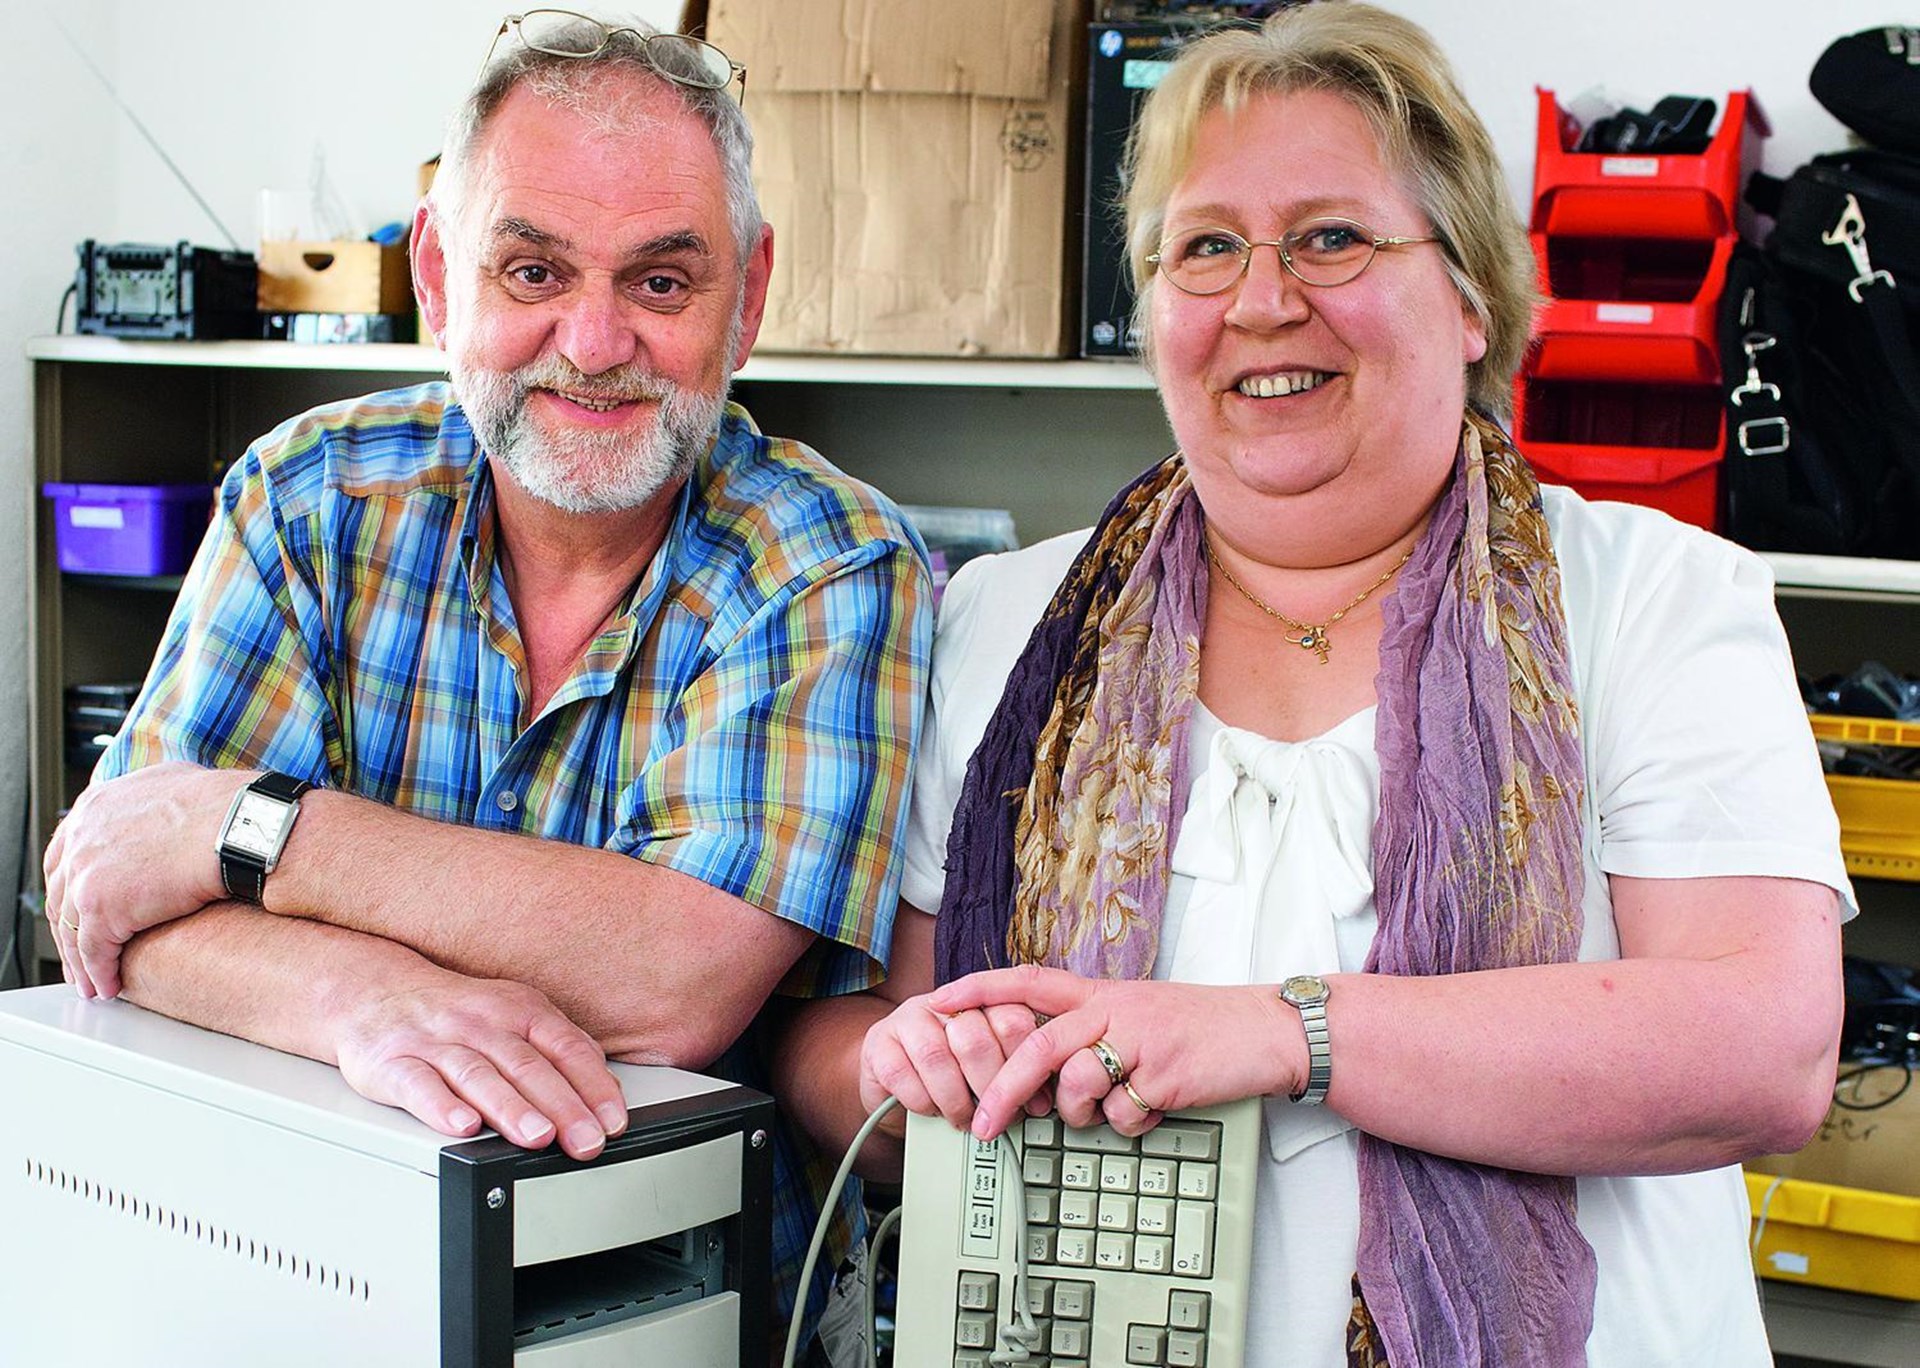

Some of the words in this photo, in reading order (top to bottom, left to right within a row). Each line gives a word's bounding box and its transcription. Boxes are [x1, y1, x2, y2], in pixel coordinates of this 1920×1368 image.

[1066, 1174, 1077, 1182] 9
[1104, 1175, 1115, 1184] 6
[1144, 1180, 1154, 1188] 3
[1102, 1215, 1113, 1223] 5
[1140, 1218, 1152, 1226] 2
[1061, 1250, 1072, 1258] 7
[1101, 1253, 1110, 1261] 4
[1177, 1260, 1188, 1269] 0
